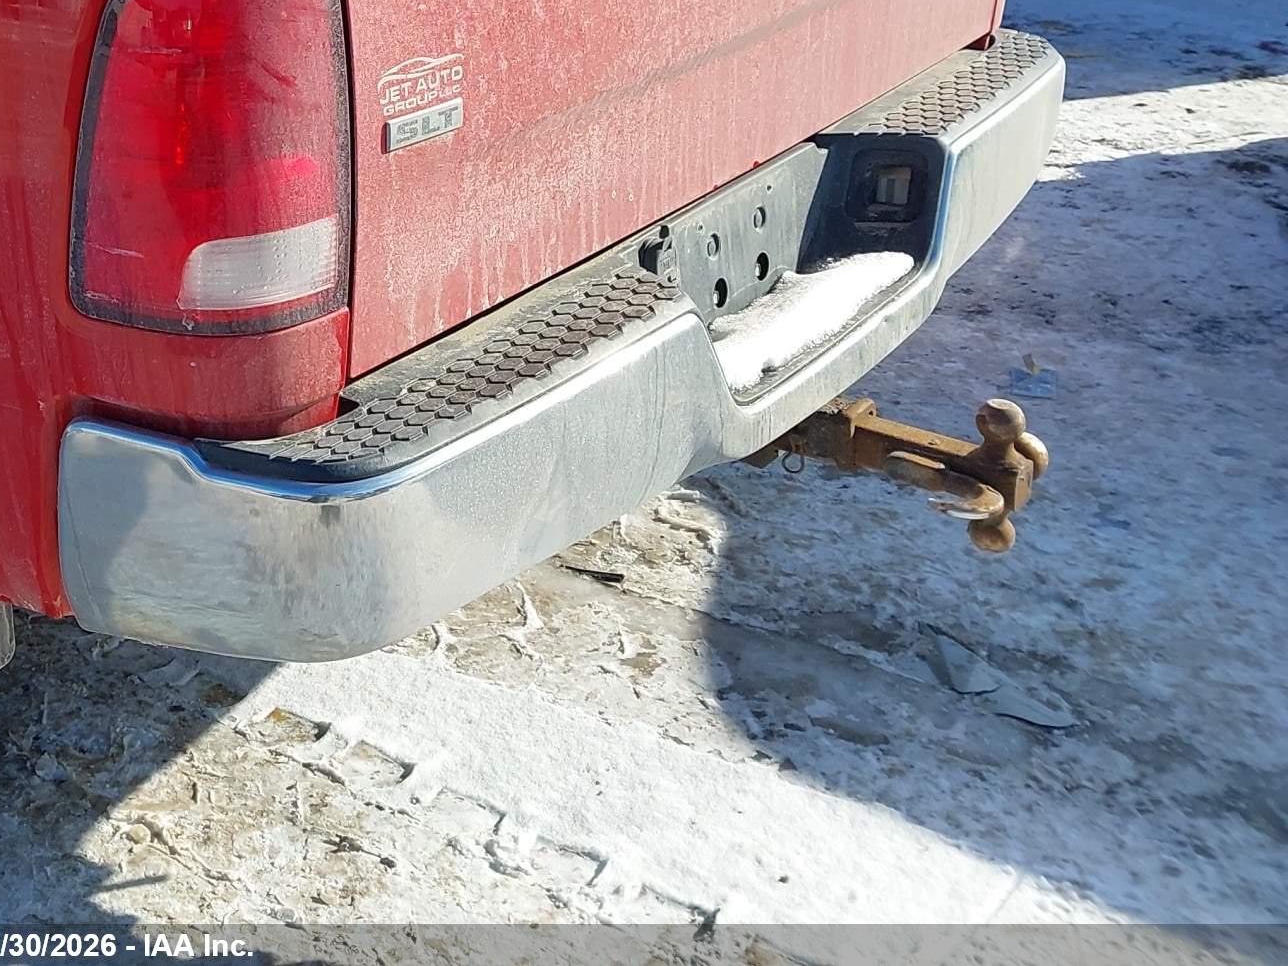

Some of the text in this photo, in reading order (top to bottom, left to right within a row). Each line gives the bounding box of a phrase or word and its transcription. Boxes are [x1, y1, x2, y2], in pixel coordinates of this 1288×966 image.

[379, 65, 463, 105] JET AUTO
[383, 89, 439, 116] GROUP
[396, 105, 459, 144] SLT
